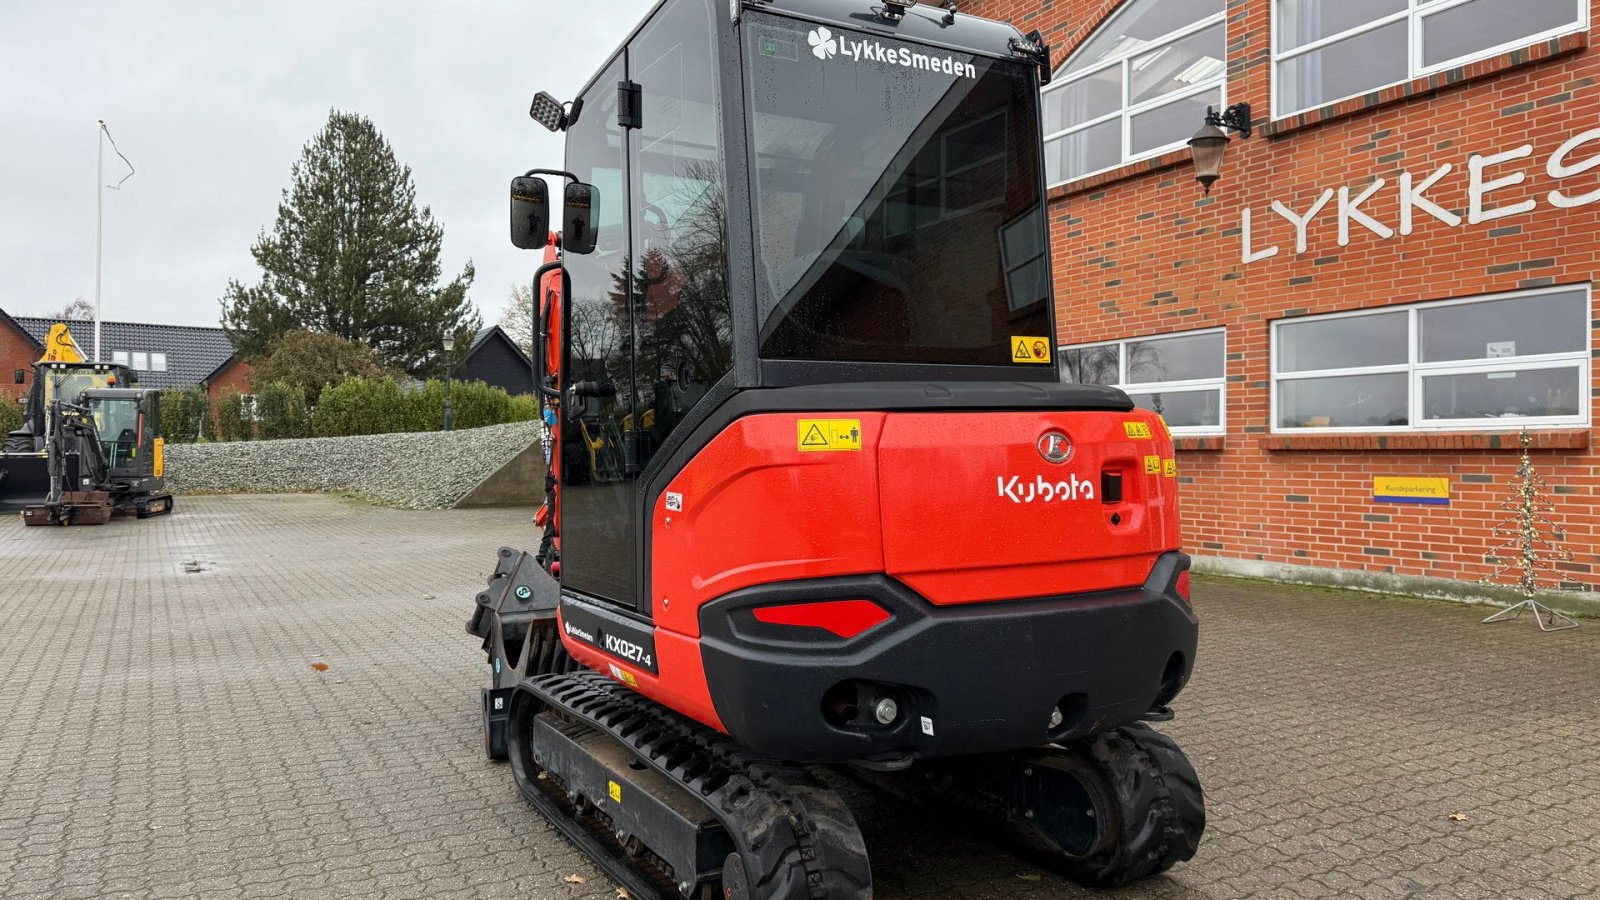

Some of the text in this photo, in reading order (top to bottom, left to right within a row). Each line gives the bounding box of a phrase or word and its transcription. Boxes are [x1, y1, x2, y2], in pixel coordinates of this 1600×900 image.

[839, 35, 977, 79] LykkeSmeden
[997, 473, 1094, 504] Kubota
[1386, 484, 1436, 494] Kundeparkering
[605, 633, 652, 667] KX027-4
